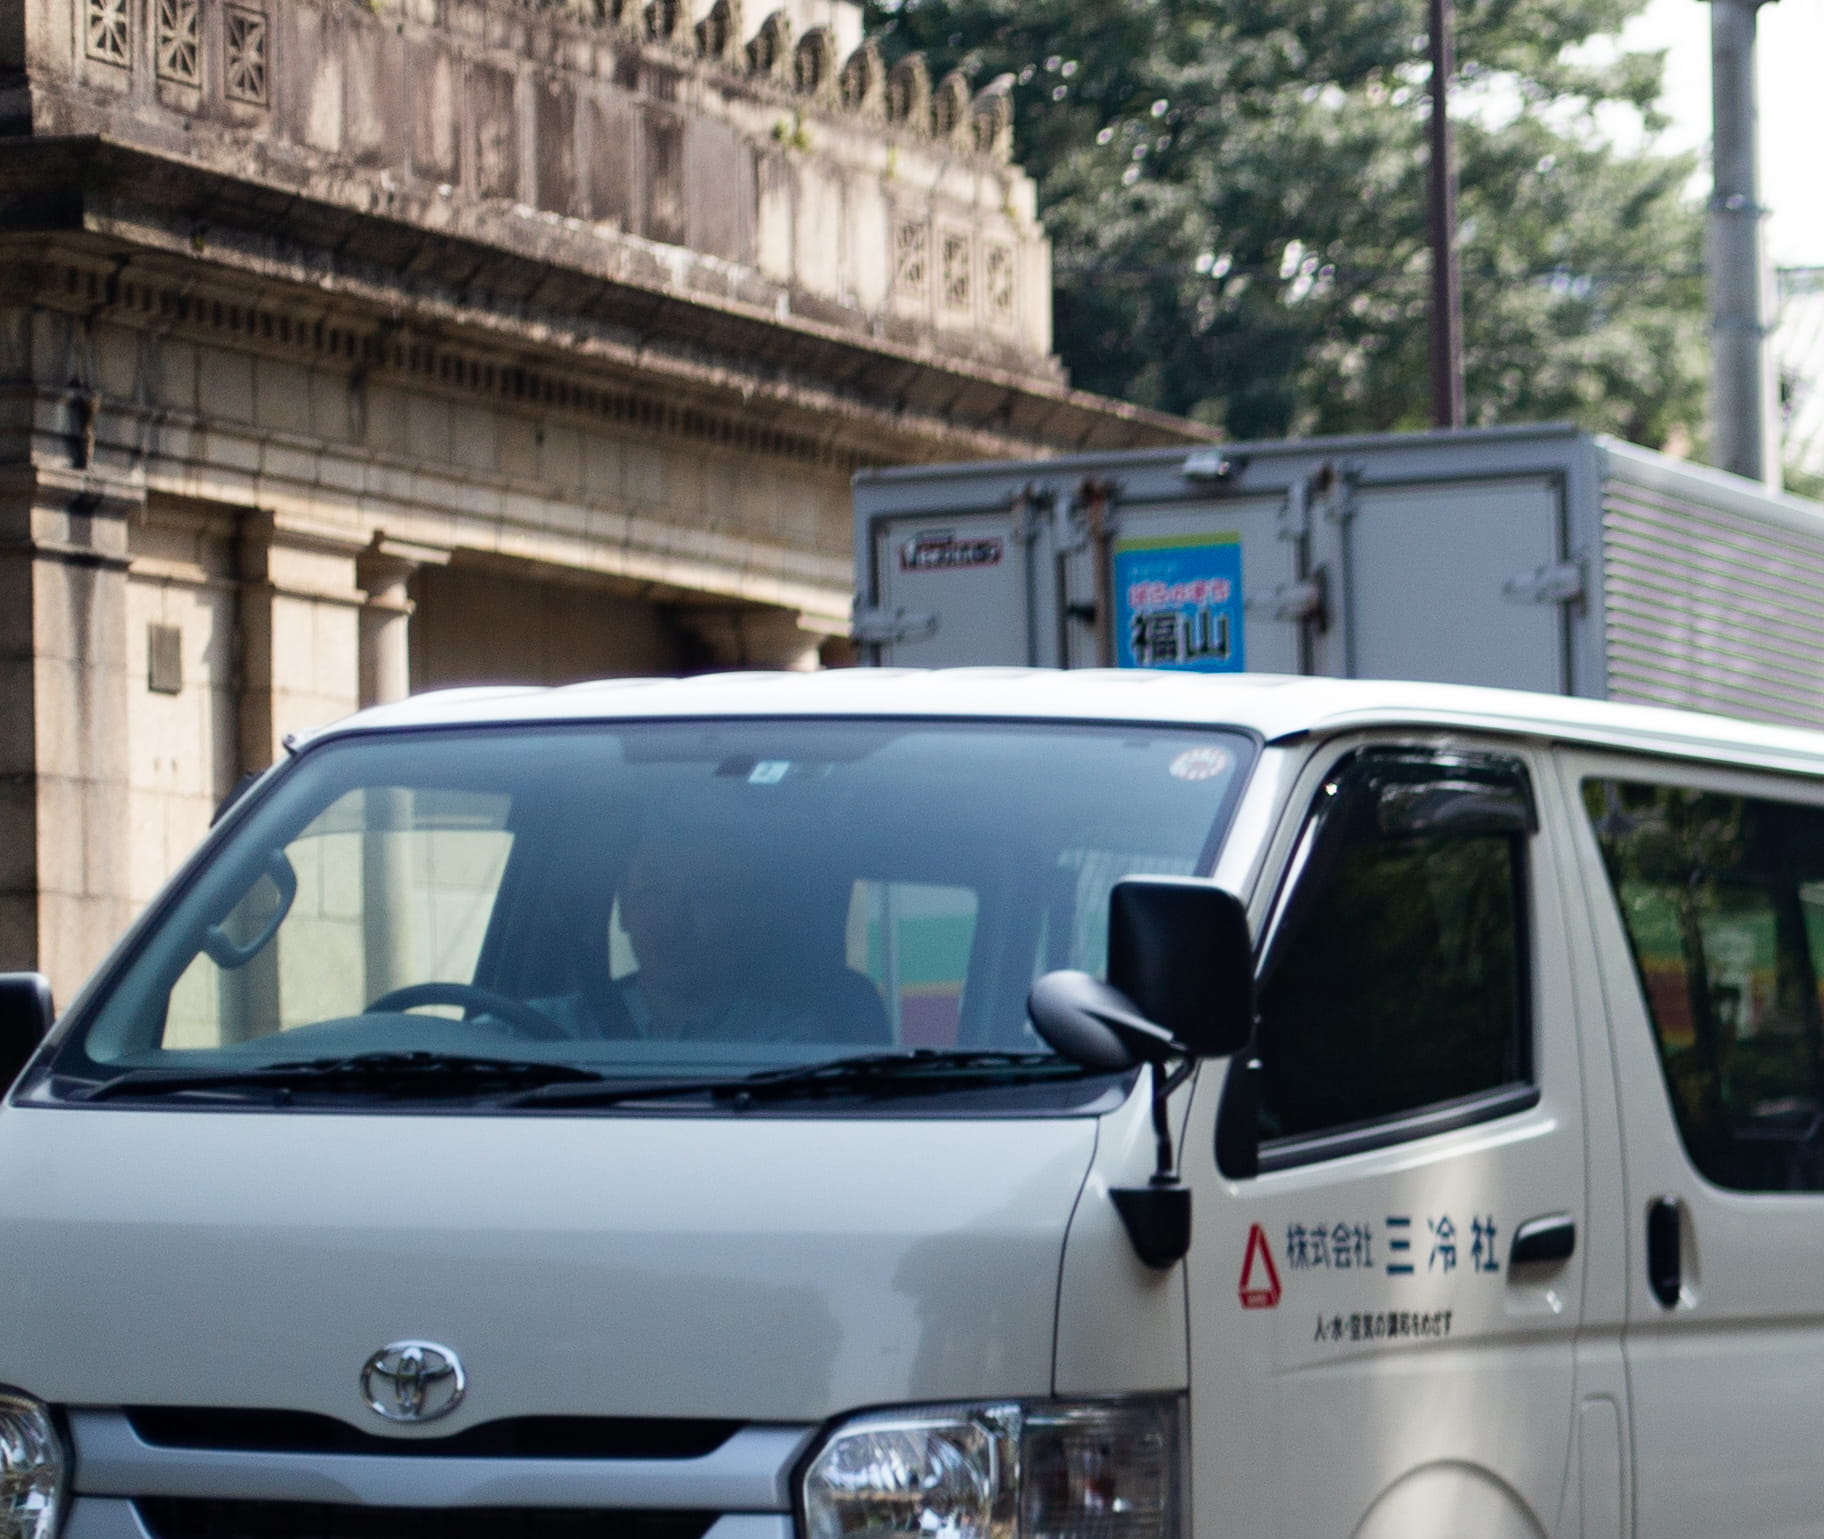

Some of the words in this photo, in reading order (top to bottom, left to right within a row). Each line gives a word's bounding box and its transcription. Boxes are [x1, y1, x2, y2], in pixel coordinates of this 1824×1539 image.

[1133, 608, 1228, 662] 福山
[1286, 1222, 1374, 1269] 株式会社
